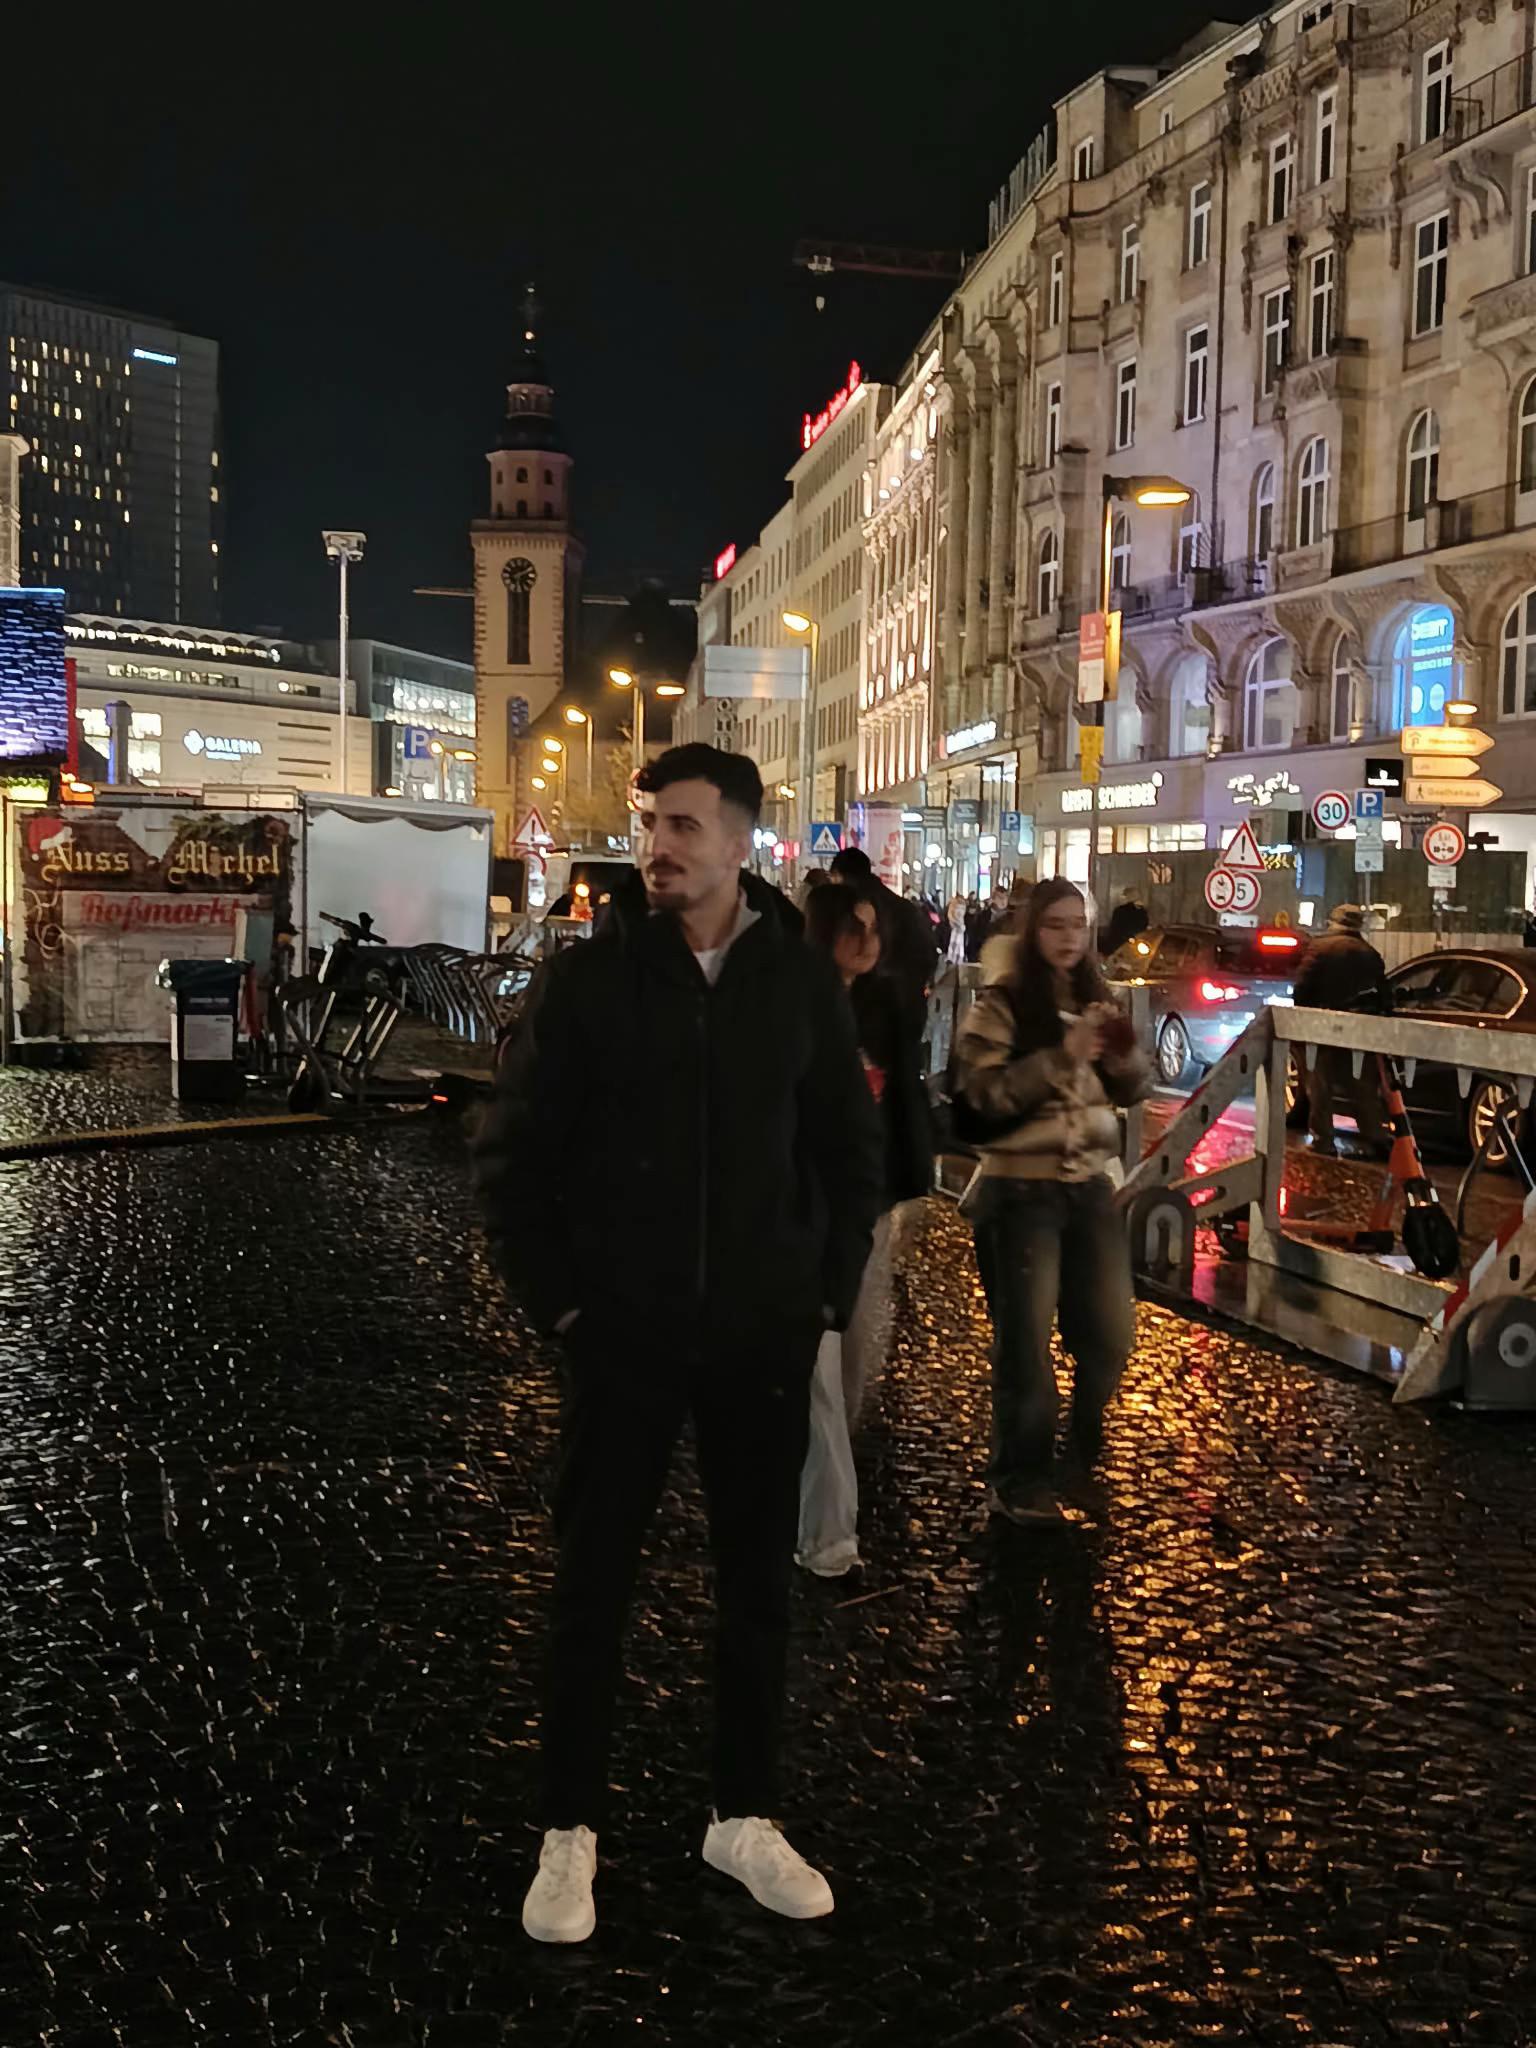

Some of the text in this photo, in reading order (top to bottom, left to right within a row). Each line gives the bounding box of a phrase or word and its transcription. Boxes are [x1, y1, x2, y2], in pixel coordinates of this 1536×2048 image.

[205, 737, 262, 754] GALERIA
[411, 730, 429, 755] P
[1321, 803, 1342, 820] 30
[1362, 793, 1378, 814] P
[1006, 813, 1018, 829] P
[168, 840, 280, 885] Michel
